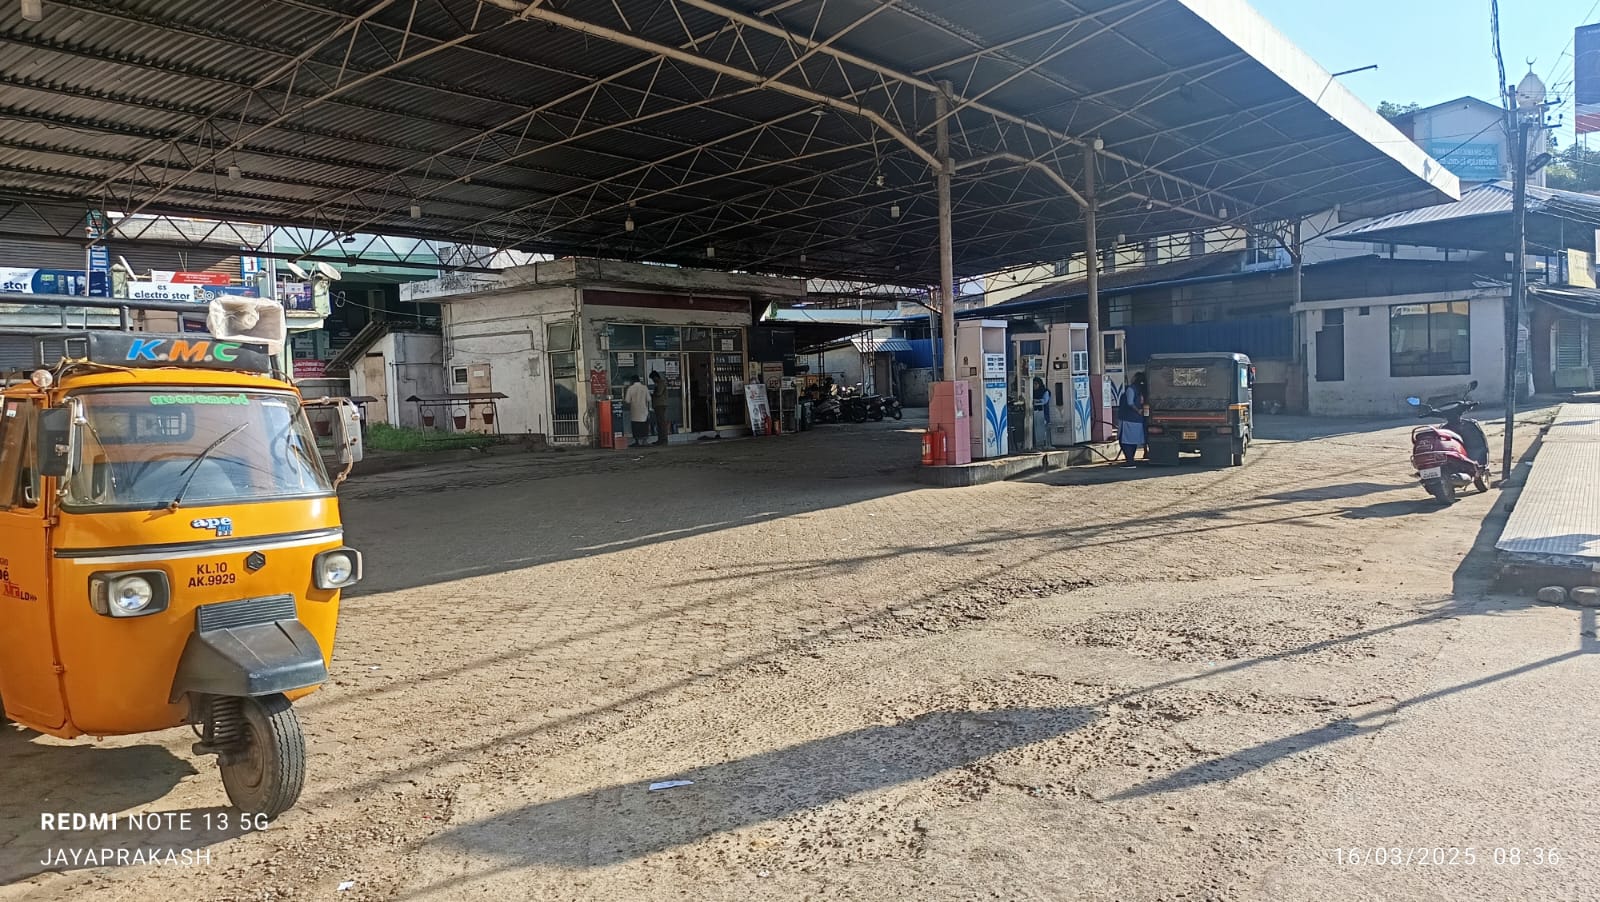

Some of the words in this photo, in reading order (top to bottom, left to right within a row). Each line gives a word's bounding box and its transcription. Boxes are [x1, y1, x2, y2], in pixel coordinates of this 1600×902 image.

[4, 280, 28, 290] star
[134, 290, 169, 299] electro
[171, 292, 190, 300] star
[126, 338, 243, 362] K.M.C
[191, 517, 232, 529] ape
[196, 562, 228, 575] KL.10
[188, 573, 236, 588] AK.9929
